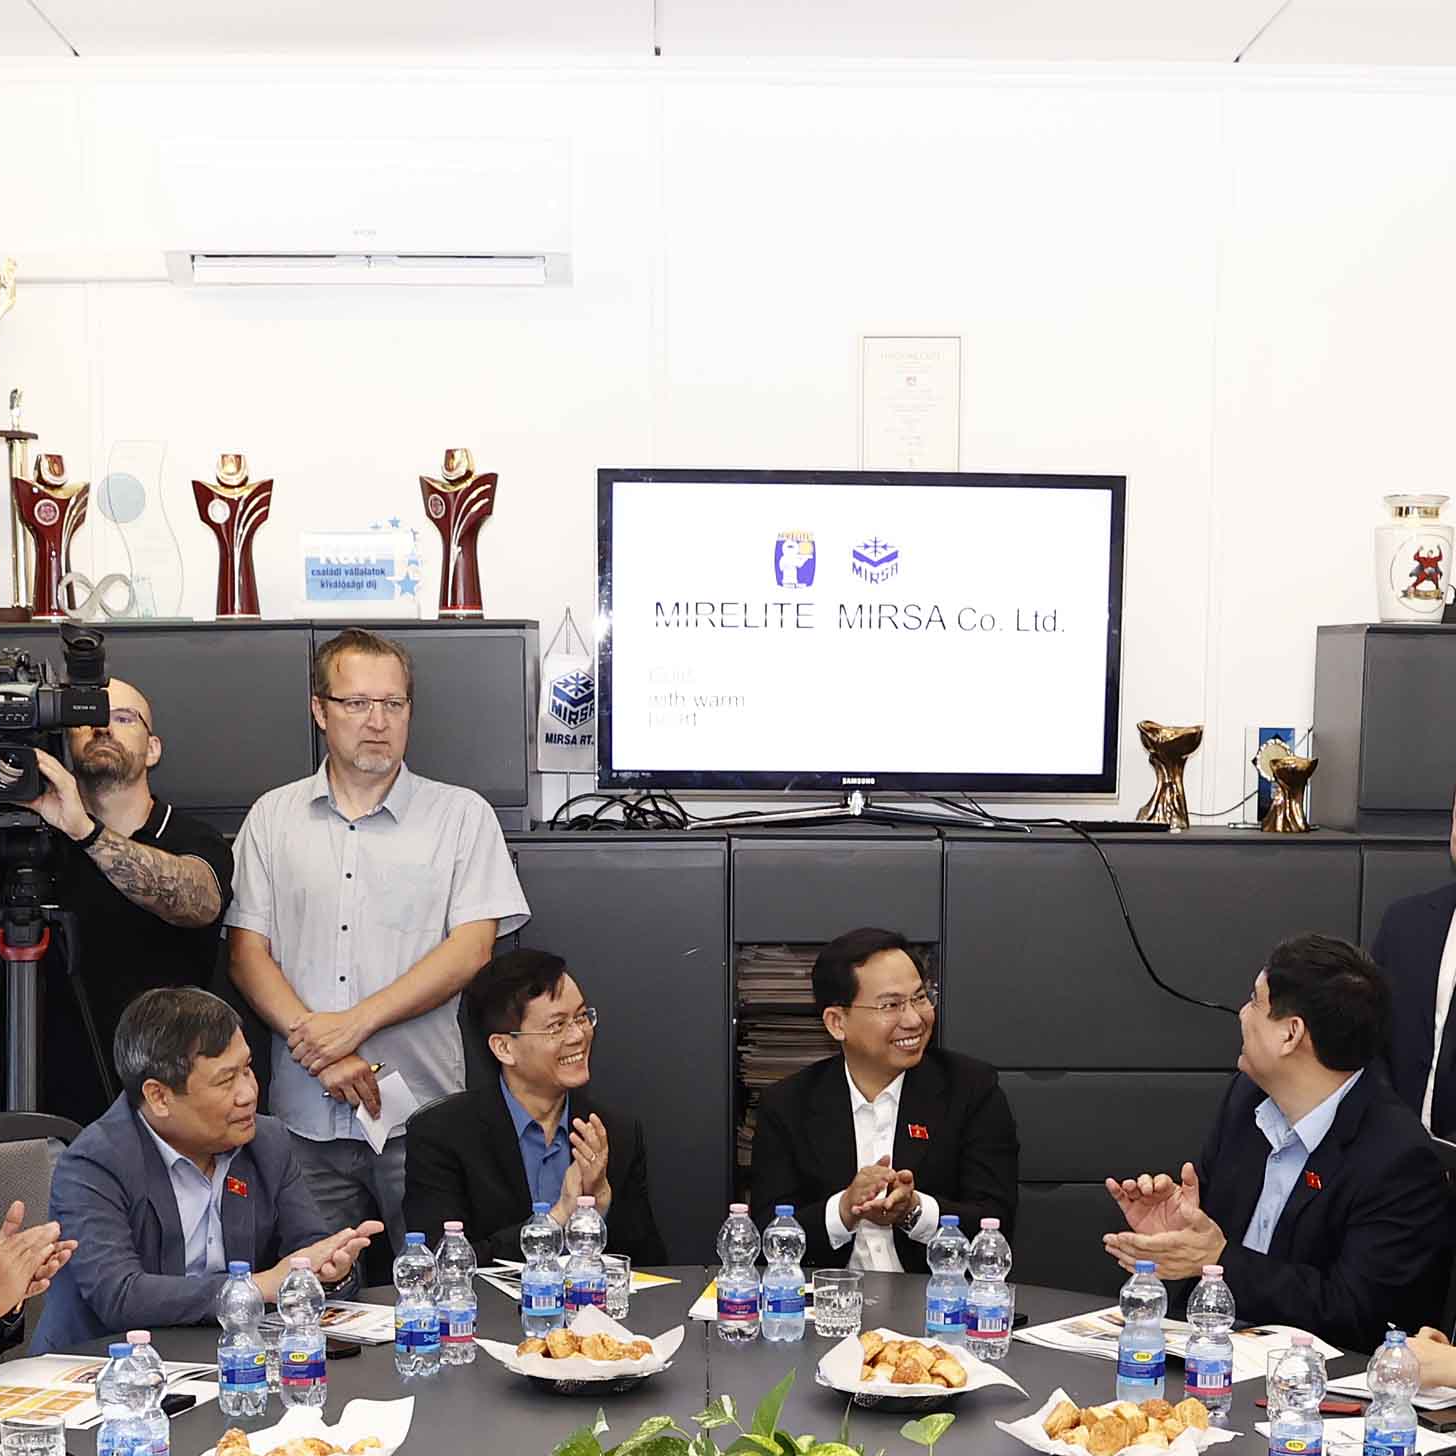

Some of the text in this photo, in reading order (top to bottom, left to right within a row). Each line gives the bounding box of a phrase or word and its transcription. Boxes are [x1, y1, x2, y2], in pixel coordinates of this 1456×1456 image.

[311, 567, 386, 577] családi vállalatok
[852, 561, 898, 585] MIRSA
[655, 602, 1066, 634] MIRELITE MIRSA Co. Ltd.
[693, 696, 745, 710] warm
[545, 732, 595, 745] MIRSA RT.
[842, 777, 876, 785] SAMSUNG
